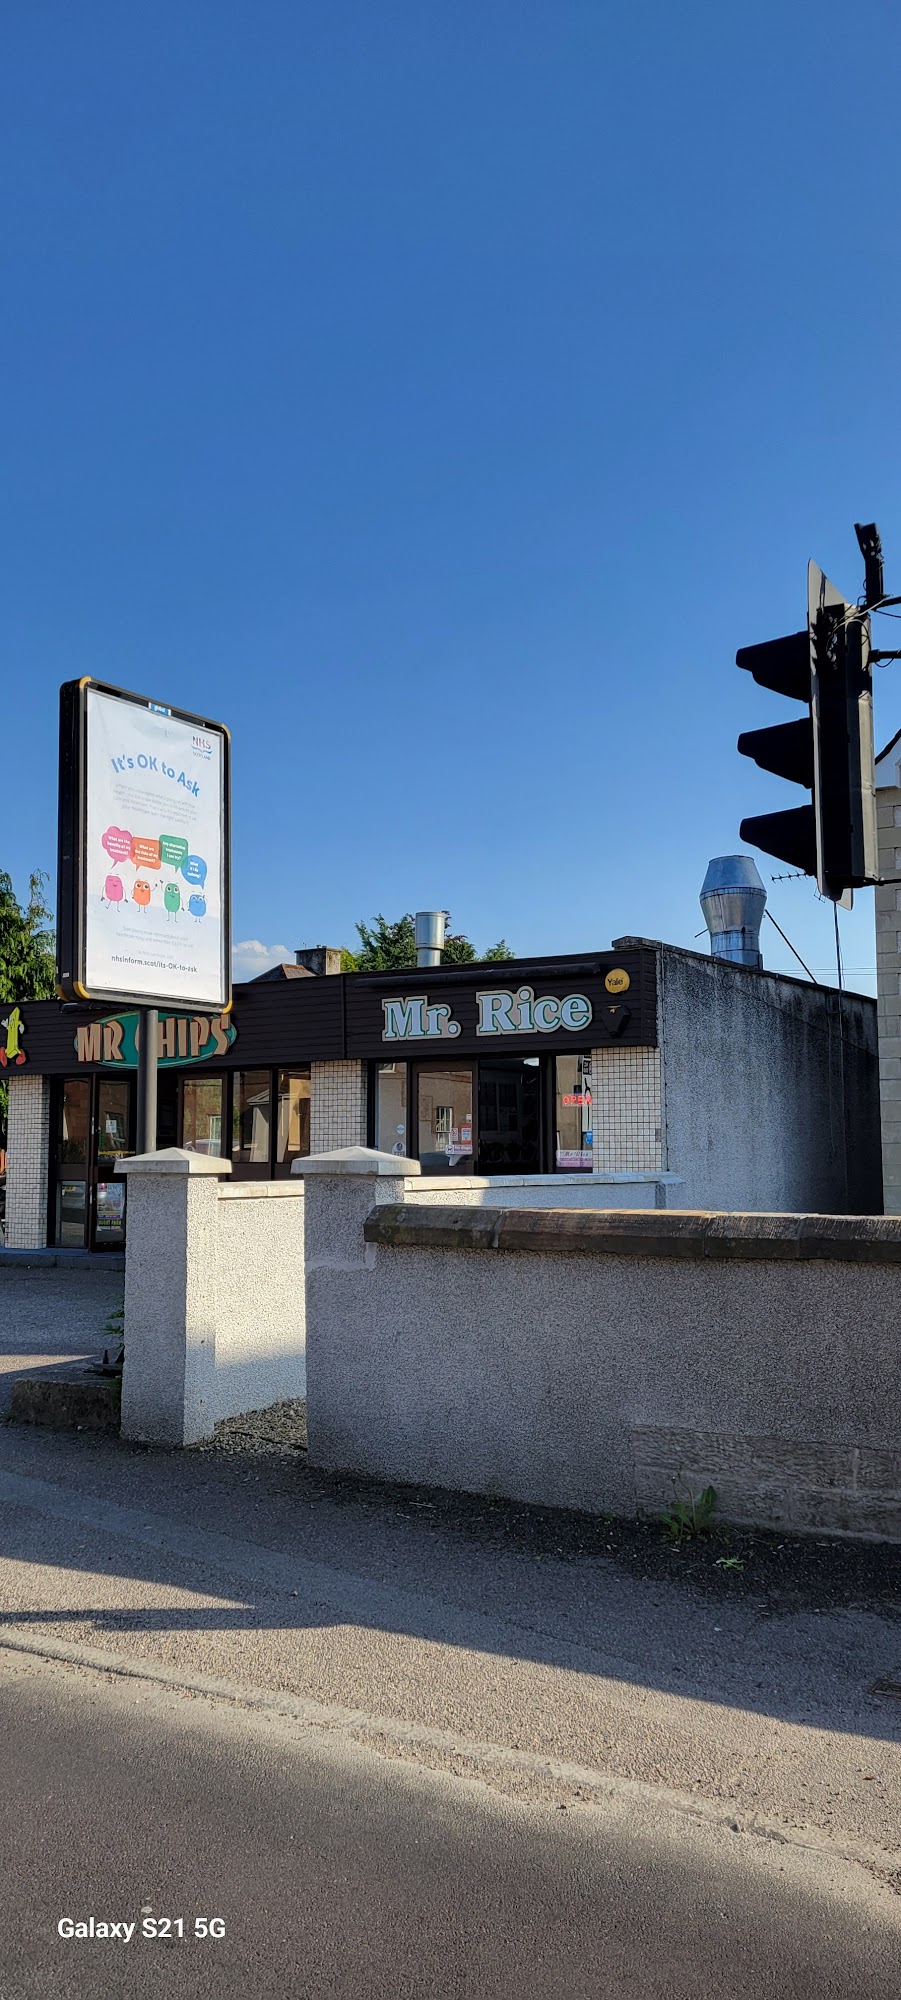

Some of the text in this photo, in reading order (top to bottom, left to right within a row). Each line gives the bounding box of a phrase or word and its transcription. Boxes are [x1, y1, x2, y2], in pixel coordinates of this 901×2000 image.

[193, 736, 211, 749] NHS
[111, 754, 200, 797] It's OK to Ask
[383, 987, 591, 1040] Mr. Rice
[77, 1021, 124, 1061] MR
[562, 1095, 592, 1105] OPEN
